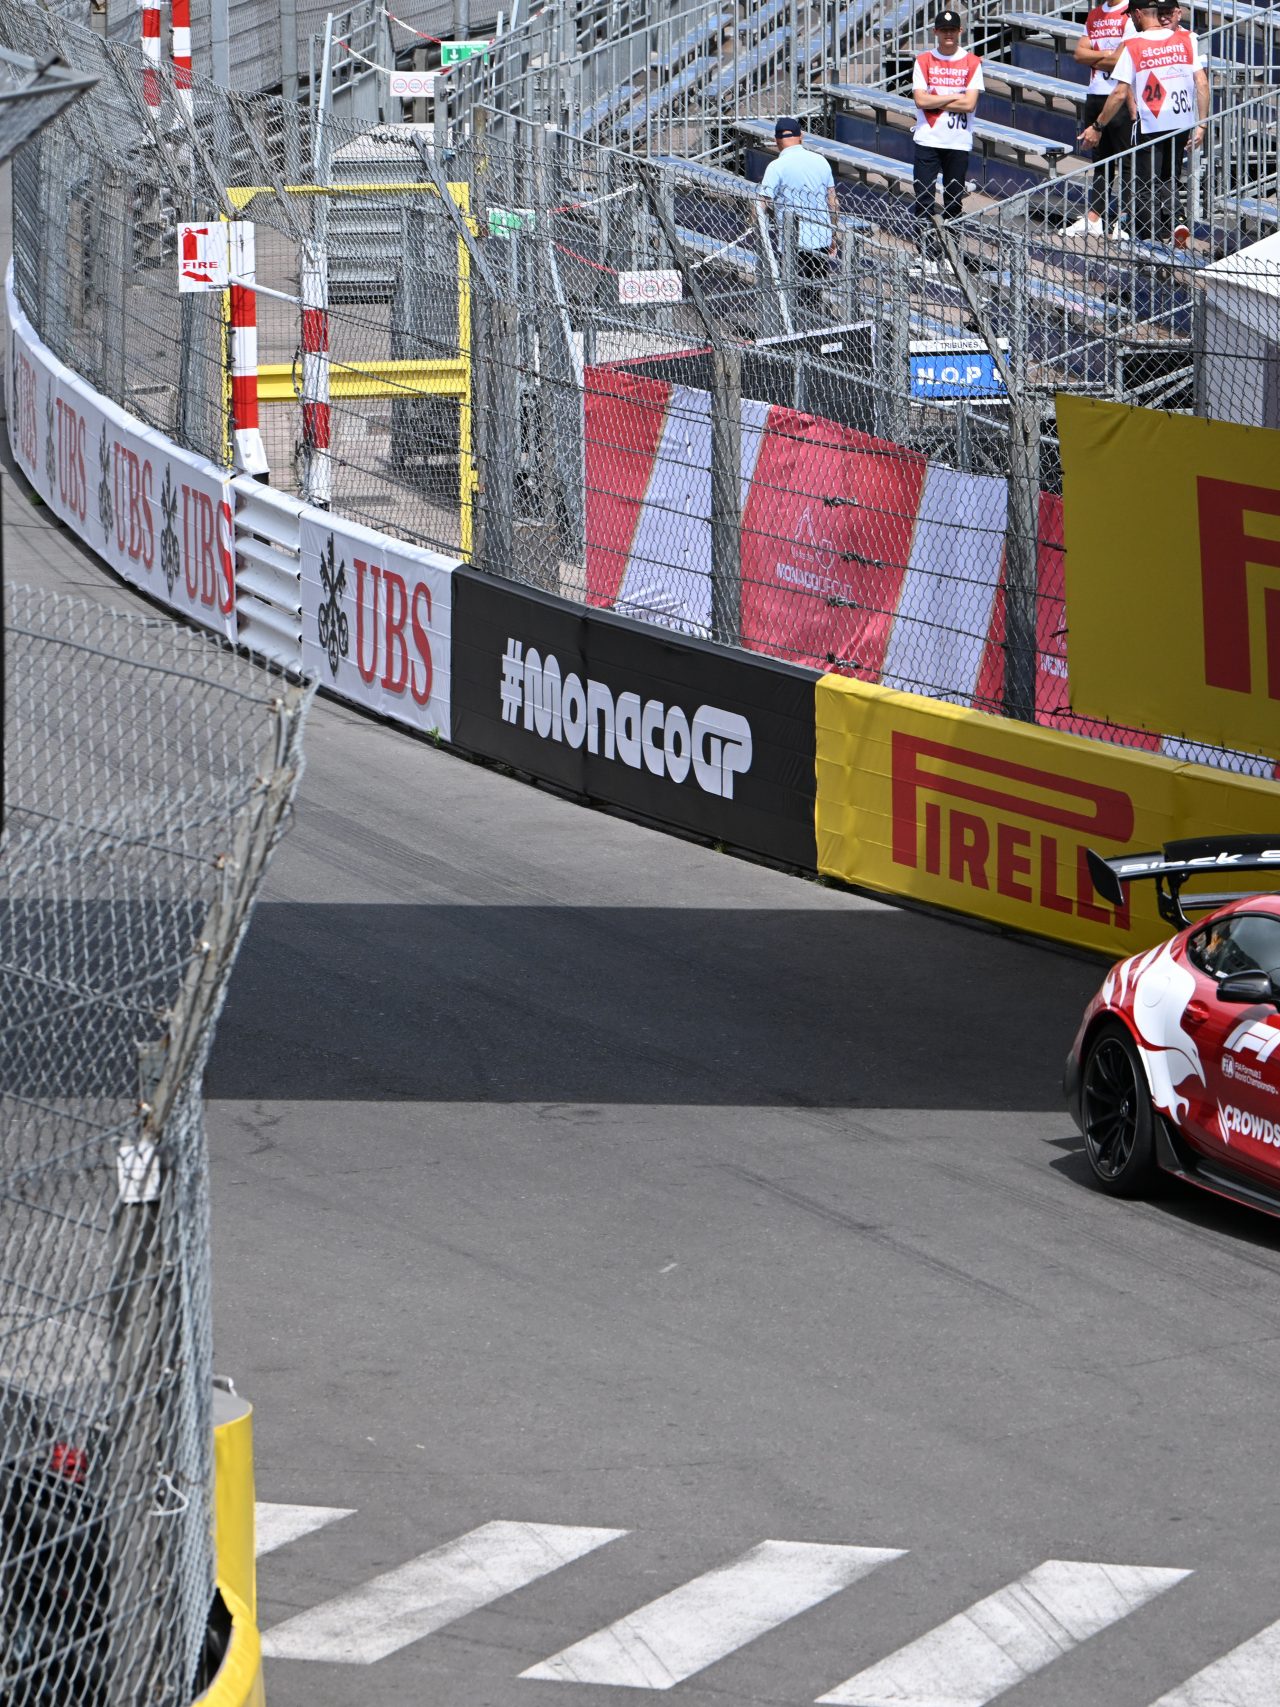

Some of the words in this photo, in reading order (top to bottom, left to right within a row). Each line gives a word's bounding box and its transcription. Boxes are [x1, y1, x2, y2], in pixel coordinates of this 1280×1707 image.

[1142, 43, 1185, 58] SÉCURITÉ
[1140, 53, 1187, 69] CONTRÔLE
[1145, 83, 1162, 102] 24
[182, 261, 218, 270] FIRE
[940, 341, 980, 350] TRIBUNES
[56, 398, 87, 522] UBS
[113, 441, 155, 570] UBS
[181, 483, 235, 614] UBS
[353, 557, 434, 706] UBS
